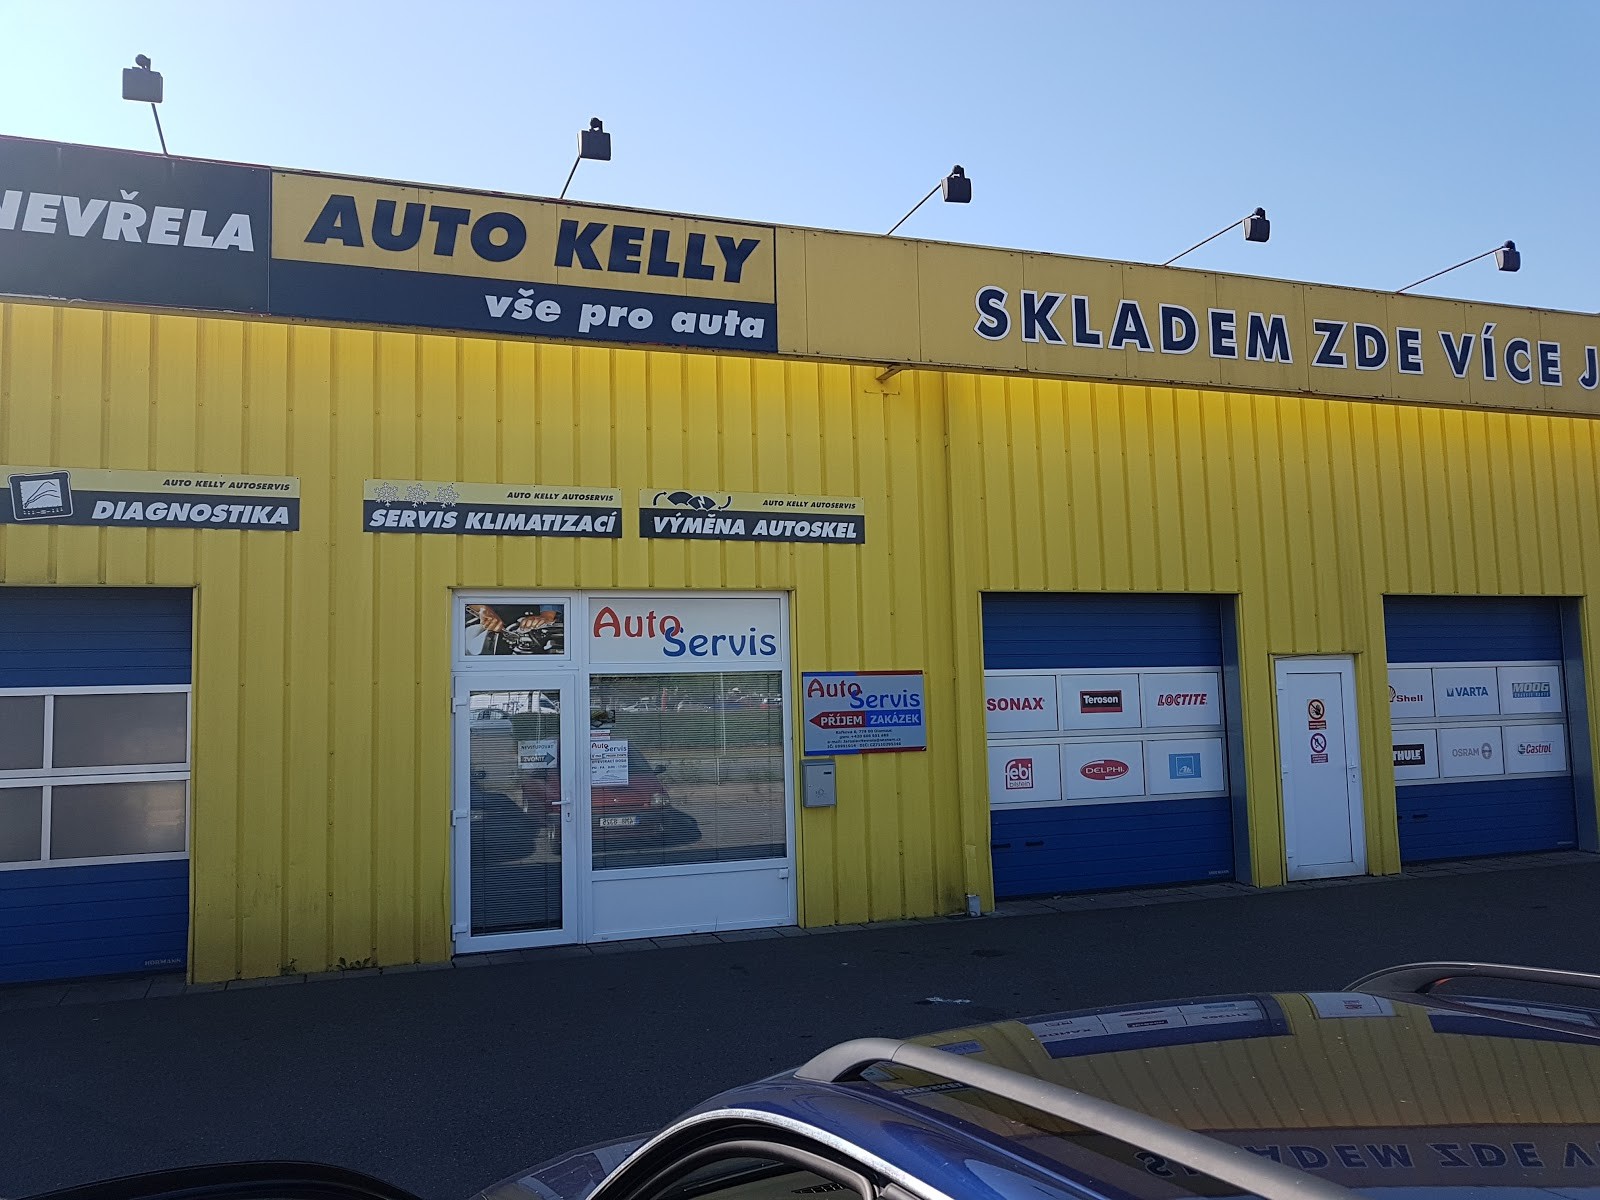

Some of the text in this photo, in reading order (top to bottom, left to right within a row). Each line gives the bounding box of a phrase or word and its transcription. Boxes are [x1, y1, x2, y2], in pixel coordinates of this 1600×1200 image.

[304, 194, 762, 284] AUTO KELLY
[485, 287, 766, 339] vše pro auta
[973, 284, 1294, 365] SKLADEM
[1311, 318, 1425, 376] ZDE
[1439, 322, 1563, 387] VÍCE
[162, 478, 291, 492] AUTO KELLY AUTOSERVIS
[507, 490, 614, 503] AUTO KELLY AUTOSERVIS
[762, 499, 857, 511] AUTO KELLY AUTOSERVIS
[91, 500, 290, 525] DIAGNOSTIKA
[369, 508, 619, 535] SERVIS KLIMATIZACÍ
[653, 511, 858, 540] VÝMĚNA AUTOSKEL
[593, 606, 681, 639] Auto
[662, 626, 777, 657] Servis
[807, 678, 862, 698] Auto
[1455, 687, 1489, 697] VARTA
[1513, 683, 1549, 692] MOOG
[849, 689, 921, 709] Servis
[986, 697, 1044, 711] SONAX
[1083, 695, 1118, 705] Teroson
[1158, 693, 1207, 706] LOCTITE
[820, 712, 920, 726] PŘÍJEM ZAKÁZEK
[1452, 748, 1480, 757] OSRAM
[1525, 742, 1551, 754] Castrol
[1005, 761, 1031, 781] febi
[1085, 766, 1123, 775] DELPHI
